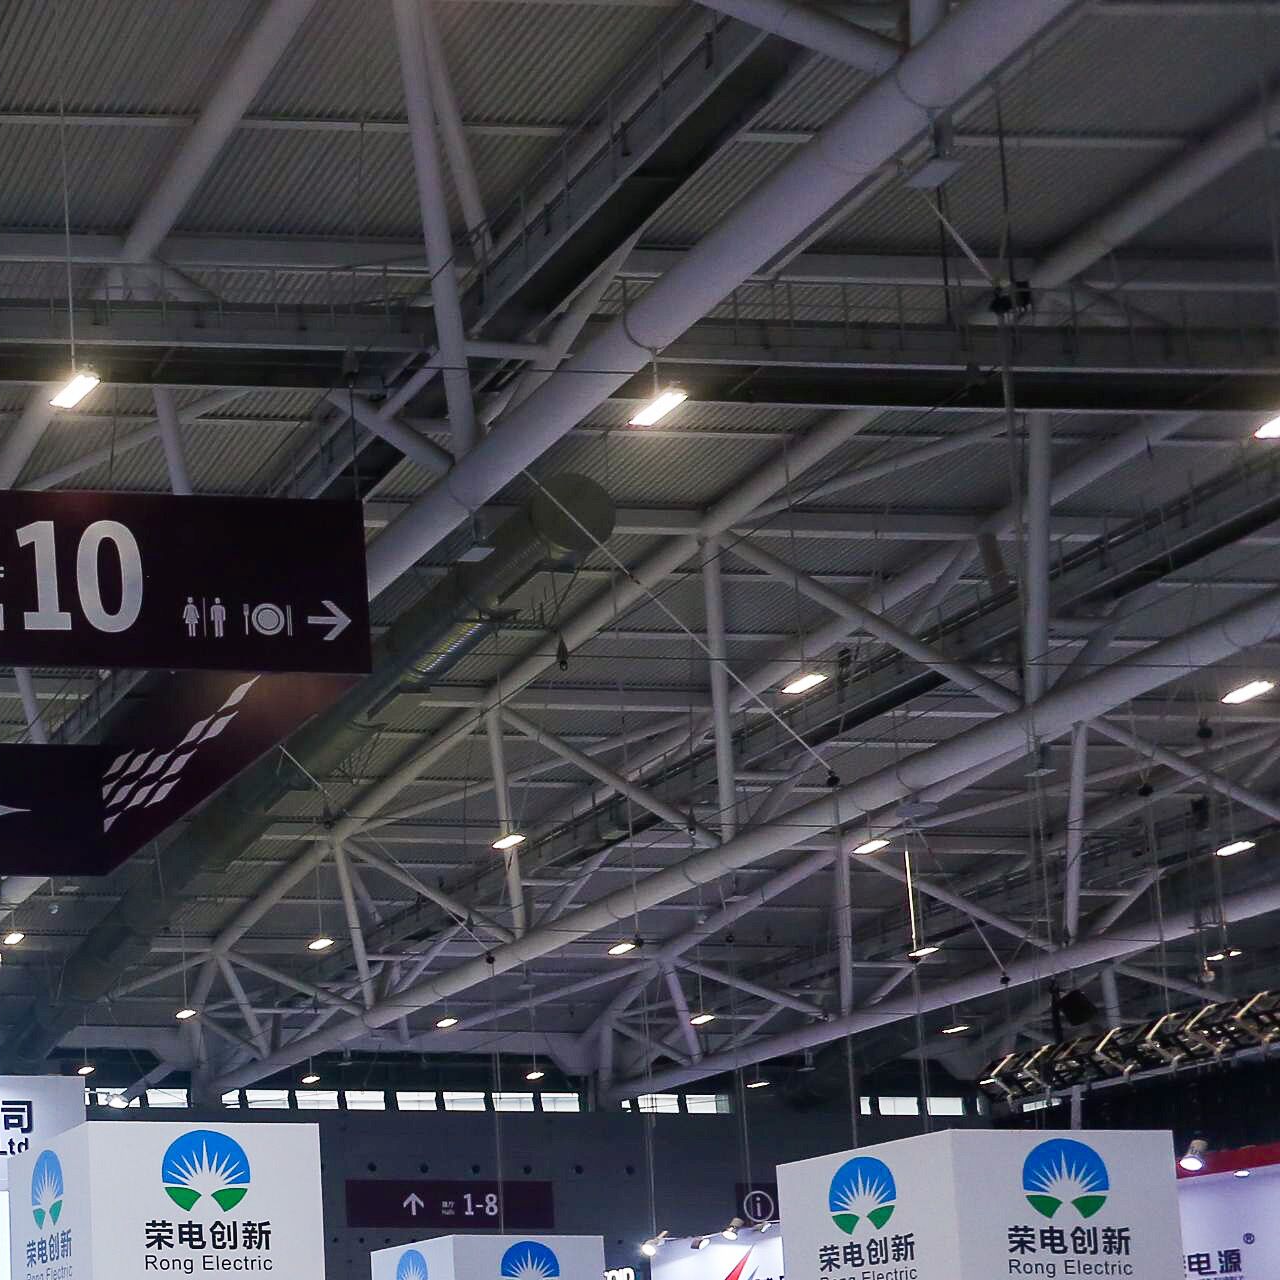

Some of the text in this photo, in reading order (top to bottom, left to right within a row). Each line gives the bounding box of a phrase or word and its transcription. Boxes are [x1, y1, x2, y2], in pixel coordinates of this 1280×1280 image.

[15, 519, 143, 633] 10
[463, 1193, 498, 1216] 1-8
[26, 1229, 72, 1268] 荣电创新
[145, 1220, 272, 1251] 荣电创新
[1008, 1226, 1130, 1256] 荣电创新
[145, 1254, 272, 1274] Rong Electric
[819, 1232, 915, 1273] 荣电创新
[1183, 1249, 1241, 1275] 电源
[1009, 1259, 1133, 1278] Rong Electric
